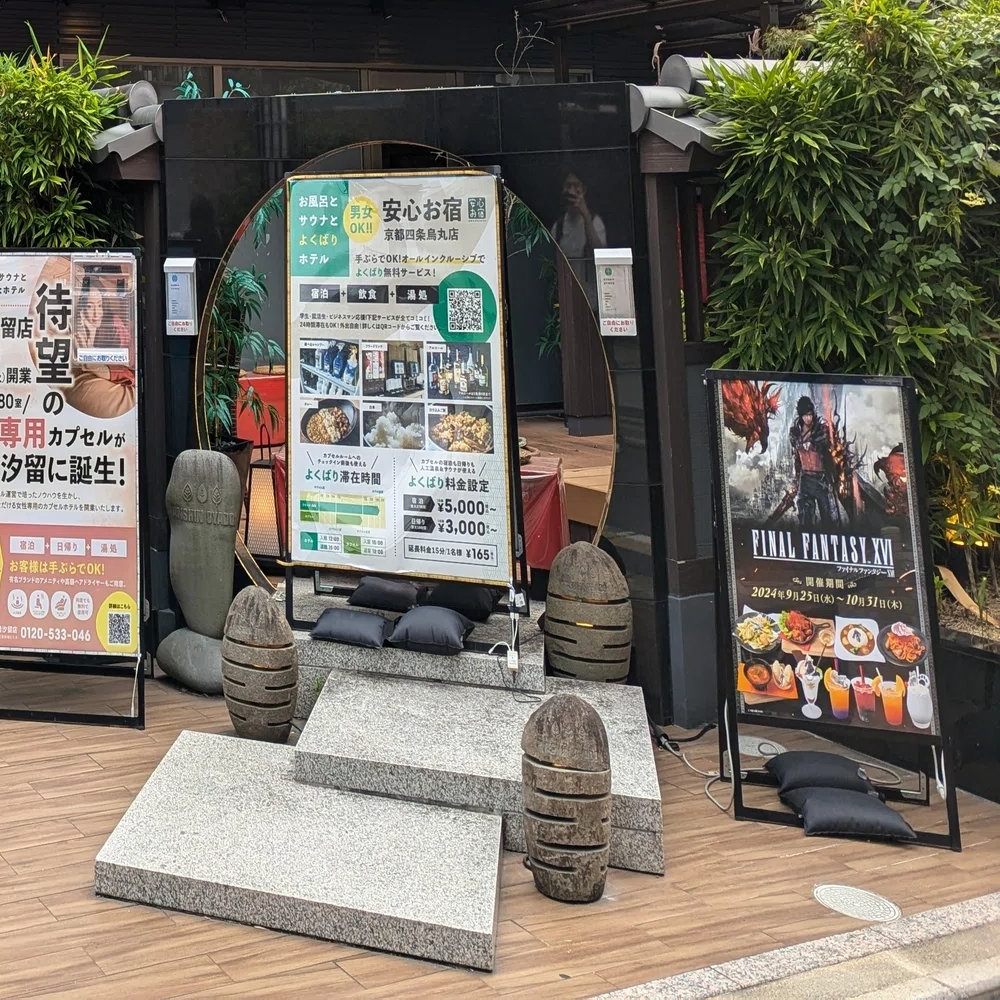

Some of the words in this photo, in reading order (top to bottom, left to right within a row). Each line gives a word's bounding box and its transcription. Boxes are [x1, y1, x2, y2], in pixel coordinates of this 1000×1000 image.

[299, 195, 338, 208] お風呂と
[350, 205, 373, 219] 男女
[382, 197, 463, 222] 安心お宿
[299, 215, 338, 227] サウナと
[350, 222, 373, 234] OK!!
[299, 234, 338, 246] よくばり
[384, 228, 459, 241] 京都四条烏丸店
[299, 254, 329, 265] ホテル
[355, 254, 485, 264] 手ぶらでOK!オールインクルーシブで
[311, 288, 329, 299] 宿泊
[358, 289, 377, 300] 飲食
[407, 289, 428, 300] 湯処
[78, 354, 127, 362] ご自由にお取りください
[323, 452, 361, 460] カプセルルームへの
[420, 459, 475, 467] カプセルの宿泊も日帰りも
[305, 468, 381, 486] よくばり滞在時間
[408, 475, 490, 493] よくばり料金設定
[19, 541, 35, 551] 宿泊
[56, 541, 78, 552] 日帰り
[751, 529, 796, 558] FINAL
[801, 533, 867, 564] FANTASY
[871, 537, 894, 566] XVI
[9, 560, 105, 575] お客様は手ぶらでOK!
[806, 576, 845, 589] 開催期間
[20, 626, 91, 642] 0120-533-046
